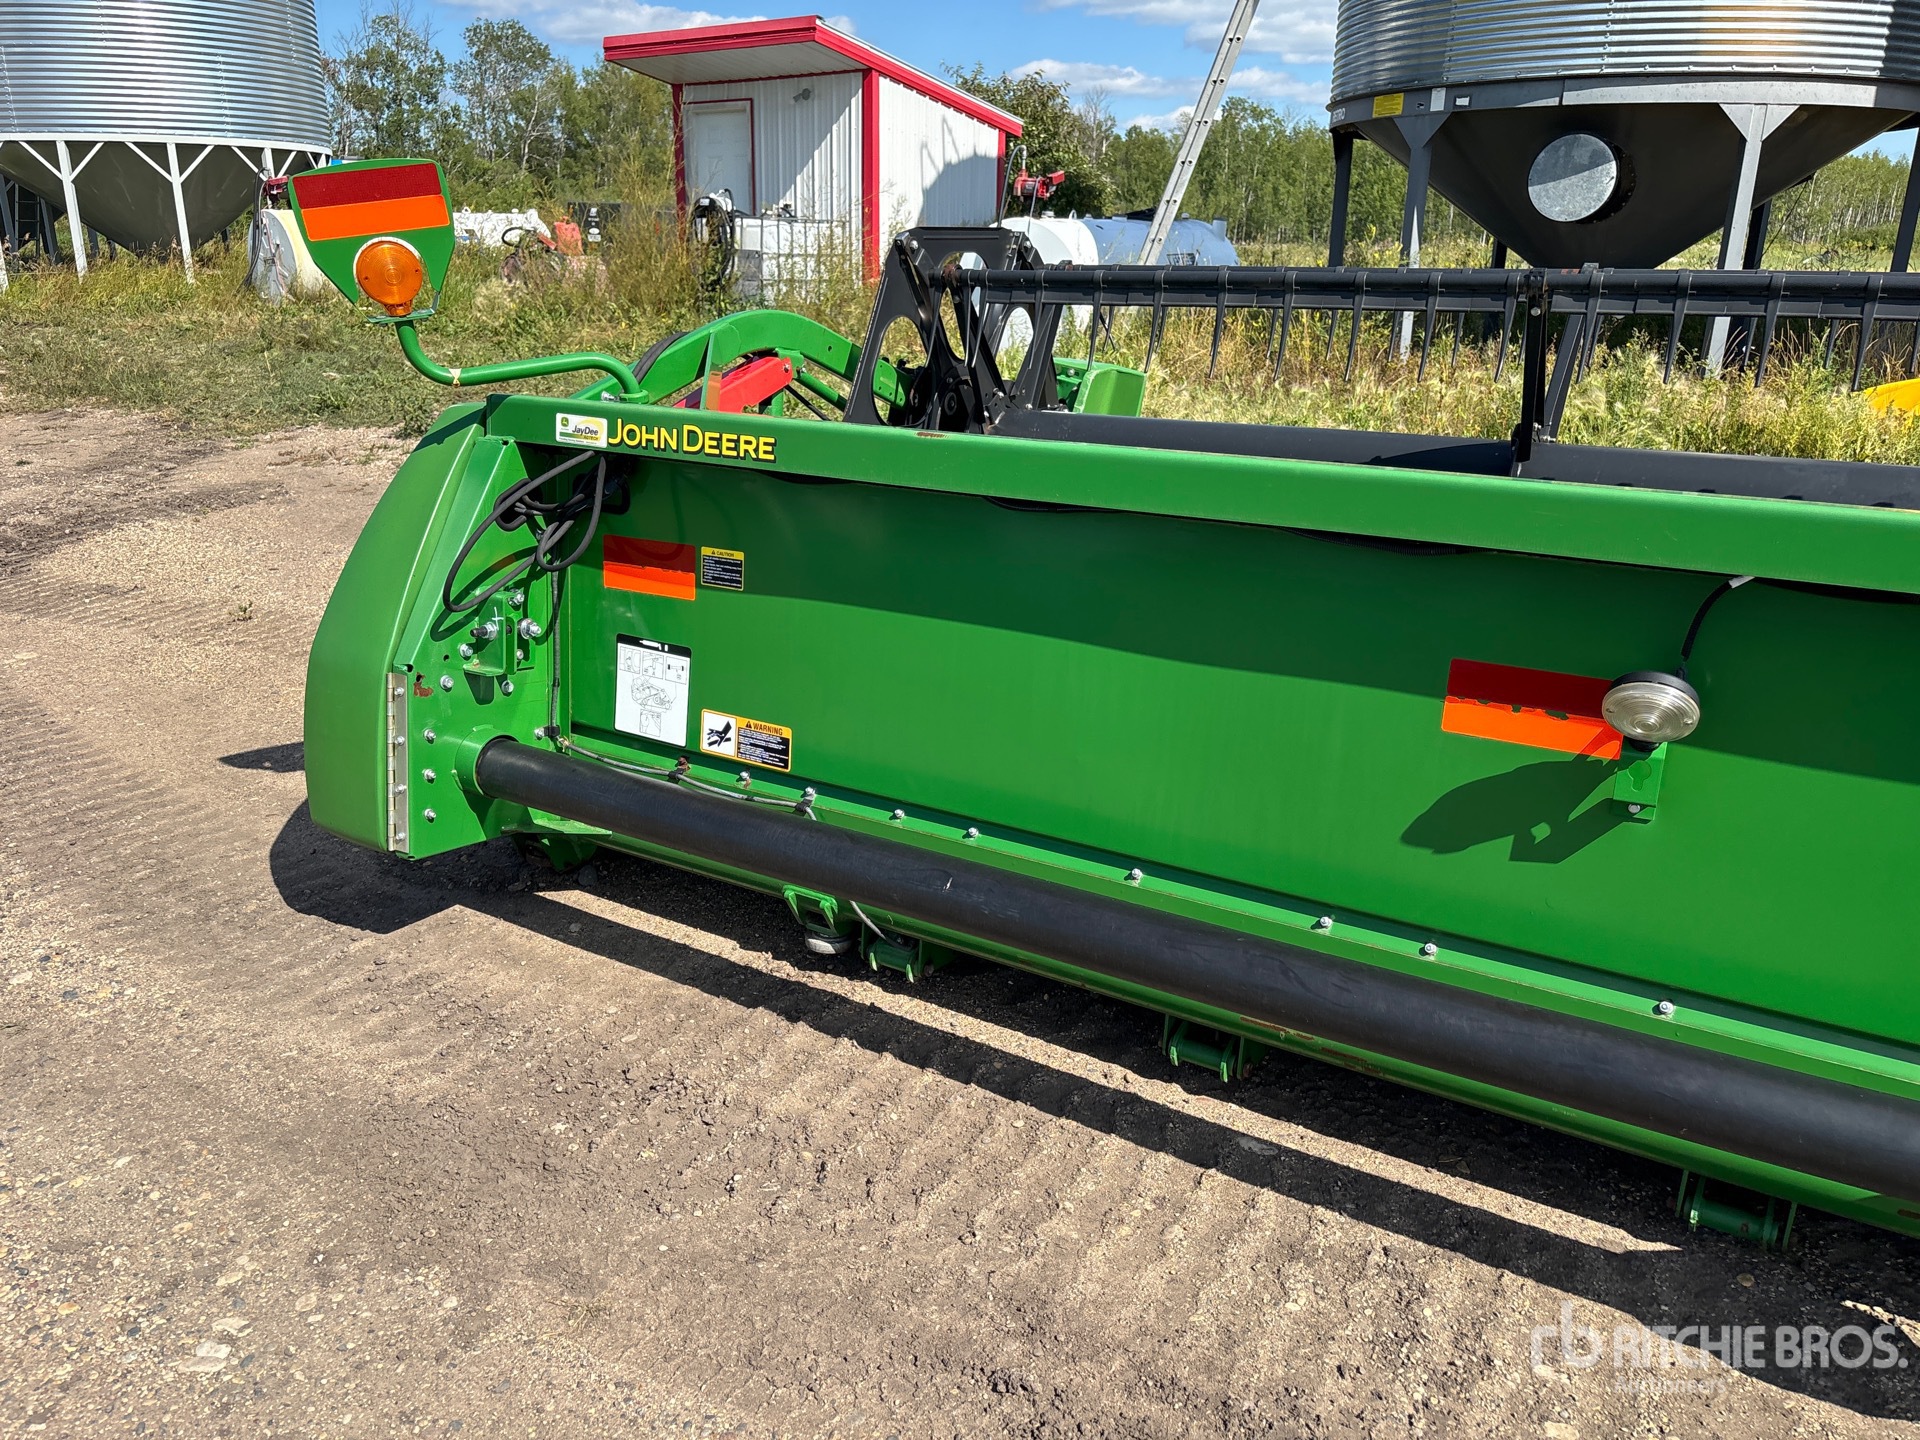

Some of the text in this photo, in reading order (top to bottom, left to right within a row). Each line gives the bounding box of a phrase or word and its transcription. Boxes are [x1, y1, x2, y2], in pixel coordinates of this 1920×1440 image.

[572, 425, 599, 436] JayDee
[608, 418, 776, 462] JOHN DEERE
[752, 721, 783, 736] WARNING
